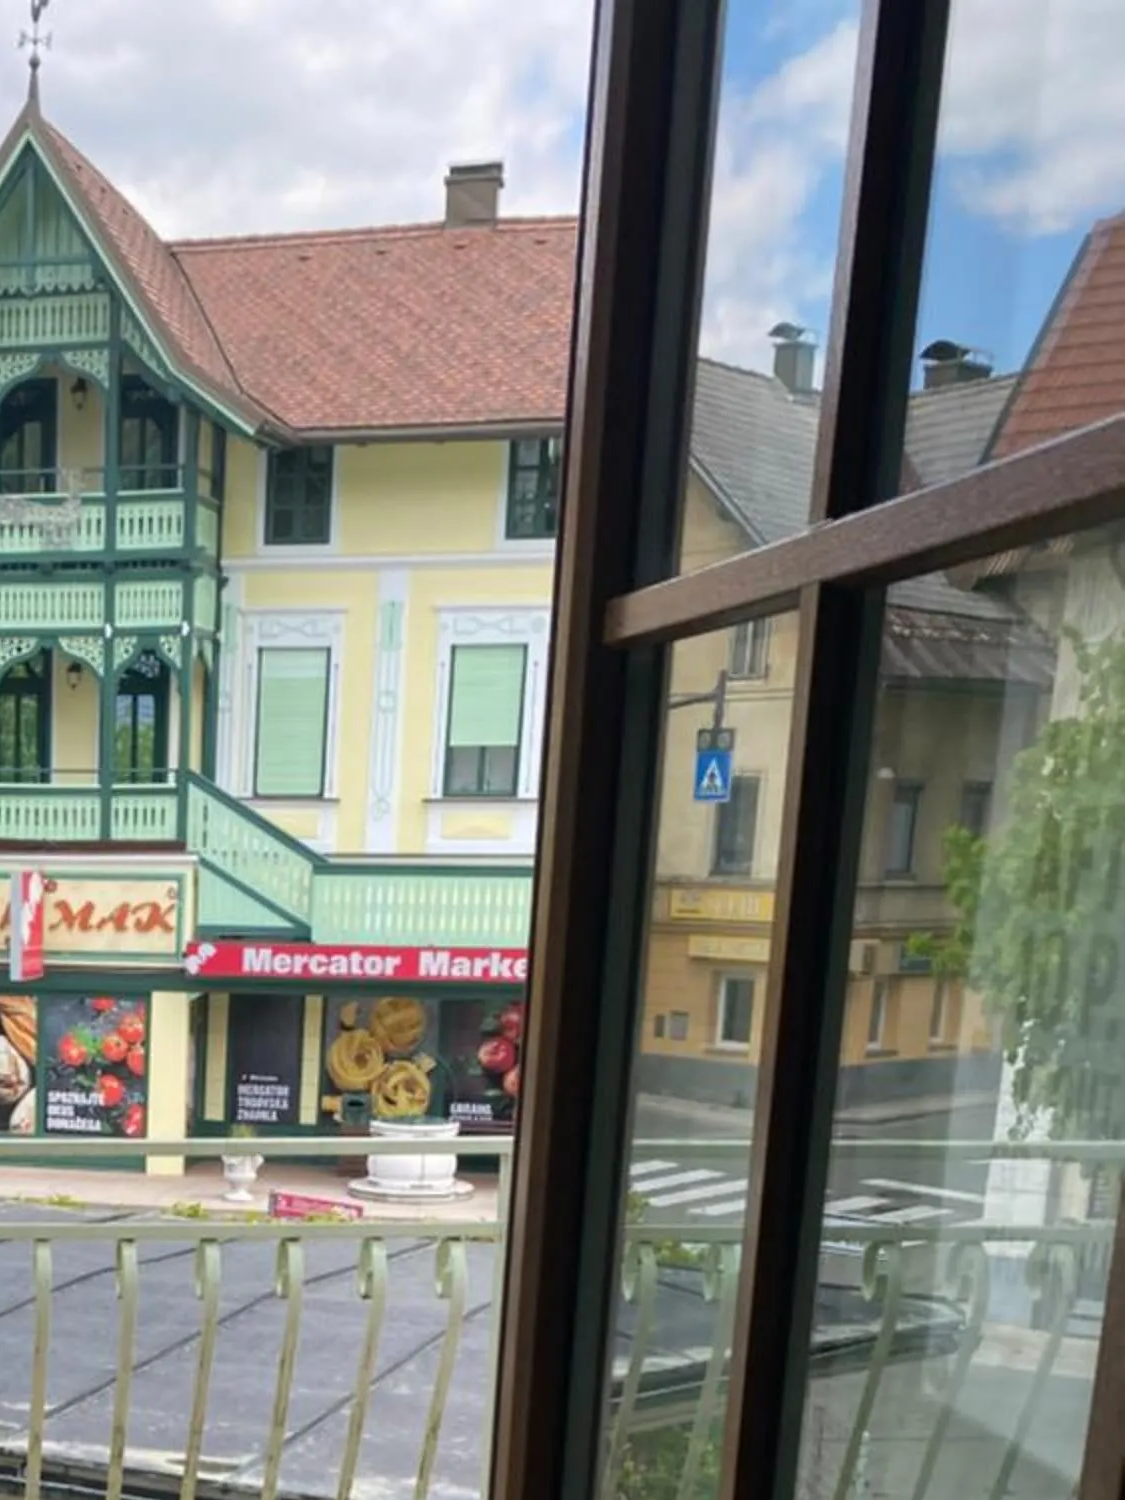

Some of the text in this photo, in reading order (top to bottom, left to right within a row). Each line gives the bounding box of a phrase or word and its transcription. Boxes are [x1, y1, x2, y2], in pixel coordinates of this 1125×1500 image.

[48, 900, 175, 933] MAK
[242, 947, 527, 979] Mercator Marke
